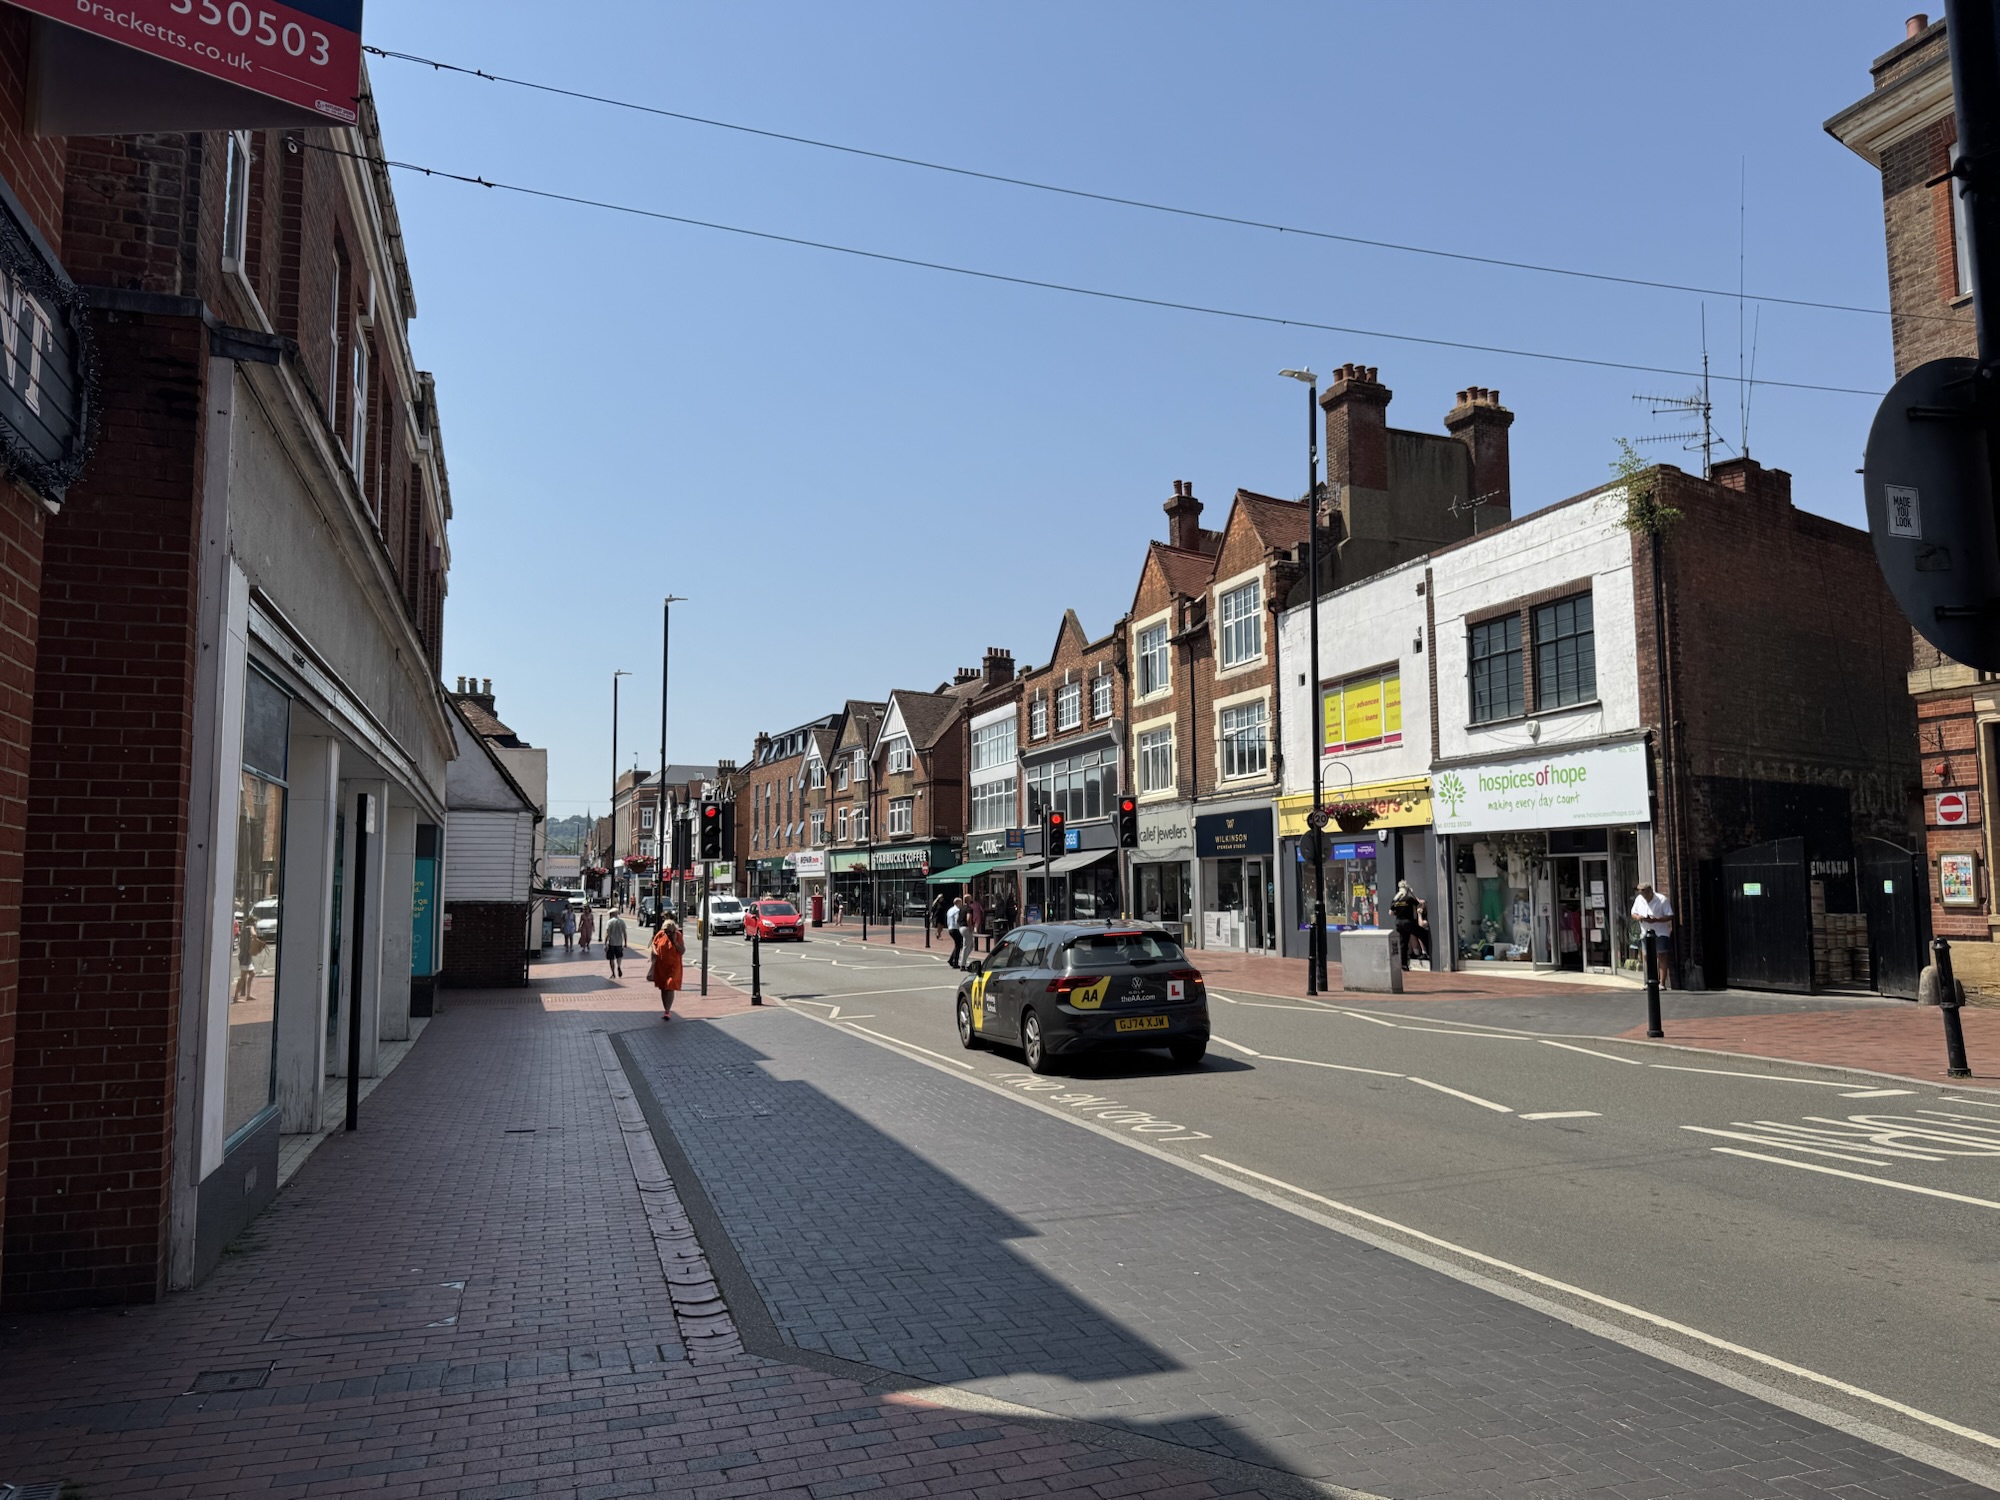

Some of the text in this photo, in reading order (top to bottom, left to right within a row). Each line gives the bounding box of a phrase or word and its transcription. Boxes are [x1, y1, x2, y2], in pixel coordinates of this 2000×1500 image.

[1893, 495, 1911, 508] MADE
[1896, 505, 1909, 518] YOU
[1895, 516, 1912, 529] LOOK
[1356, 697, 1379, 709] advances
[1365, 713, 1378, 722] loans
[1488, 791, 1580, 812] making every day count
[1315, 814, 1327, 823] 20
[1215, 833, 1248, 843] WILKINSON
[981, 839, 999, 855] COOK
[873, 850, 927, 864] STARBUCKS COFFEE
[1081, 989, 1098, 1002] AA
[1171, 984, 1180, 997] L
[1121, 994, 1156, 1003] theAA.com
[1120, 1018, 1144, 1030] GJ74
[989, 1072, 1212, 1142] LOADING ONLY
